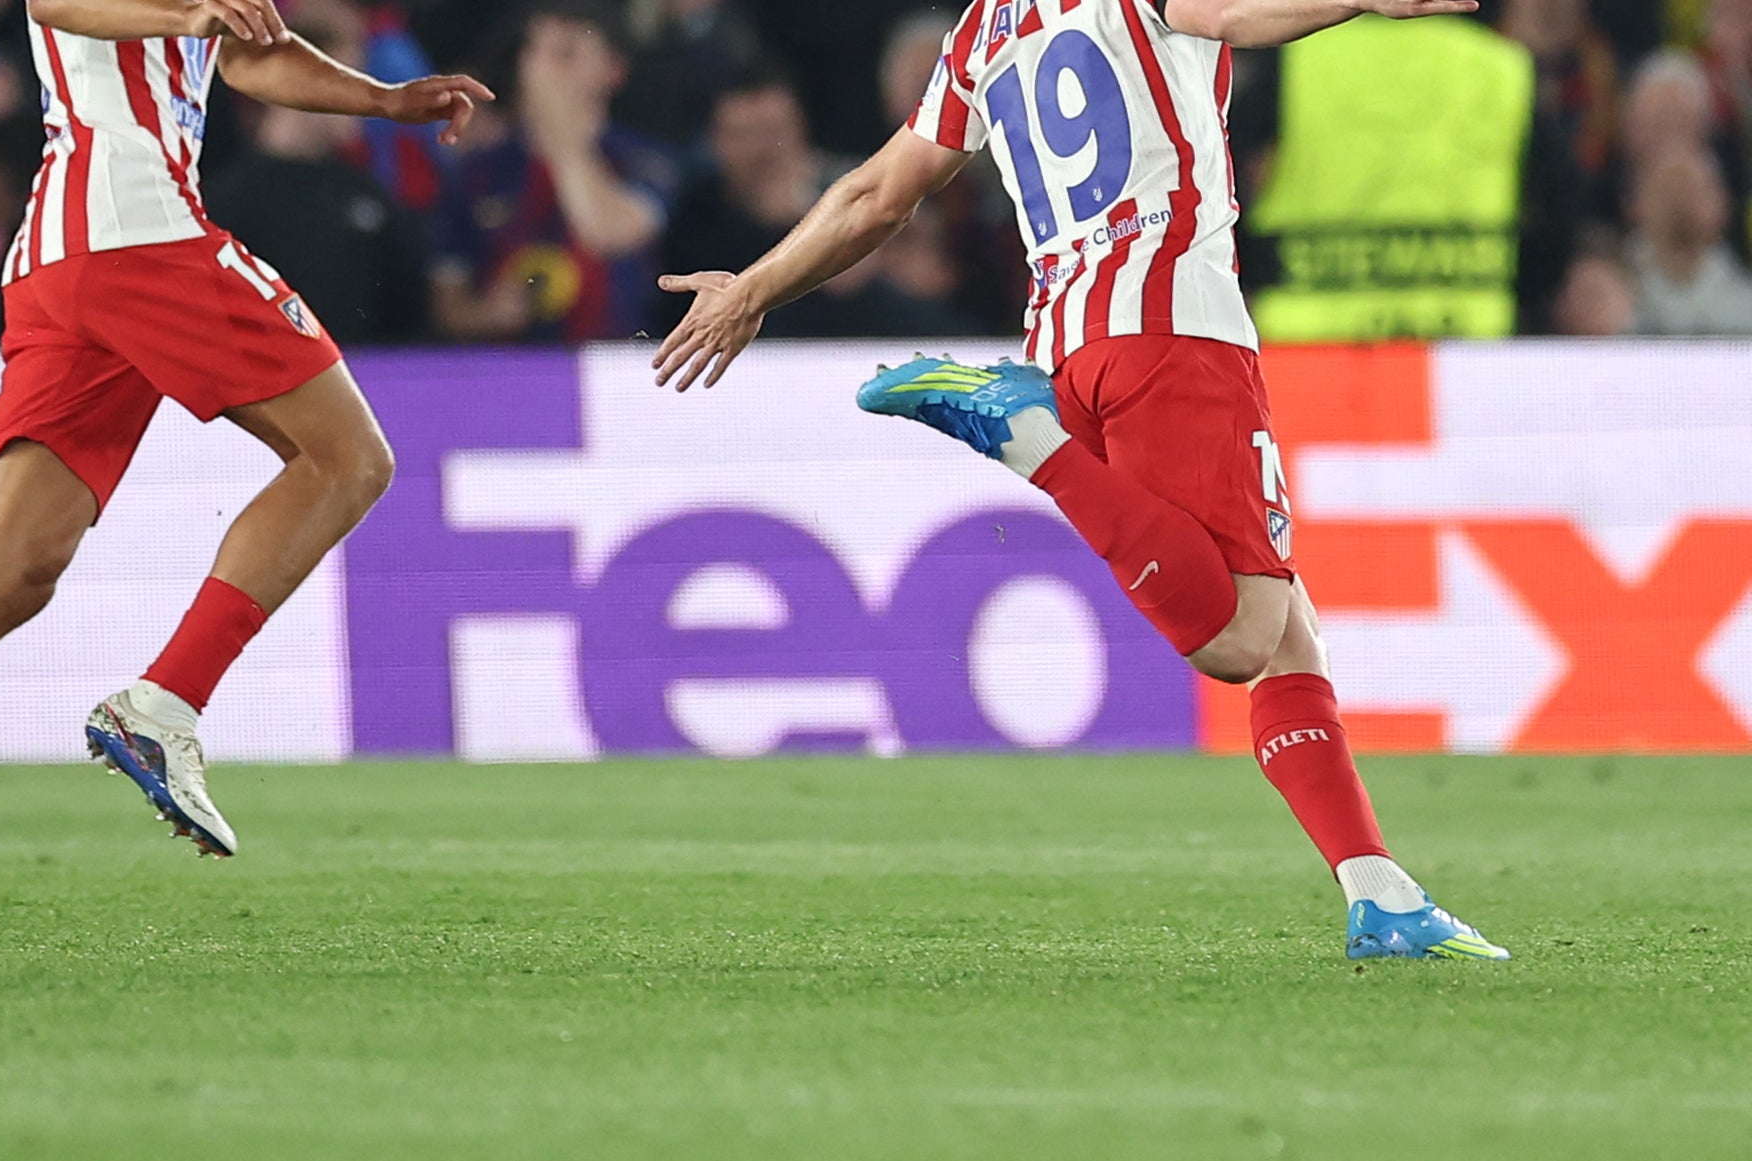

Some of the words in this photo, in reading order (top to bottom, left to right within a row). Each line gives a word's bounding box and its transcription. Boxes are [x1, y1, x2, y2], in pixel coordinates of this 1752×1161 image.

[985, 29, 1132, 248] 19
[1093, 209, 1172, 245] Children
[1261, 728, 1330, 766] ATLETI
